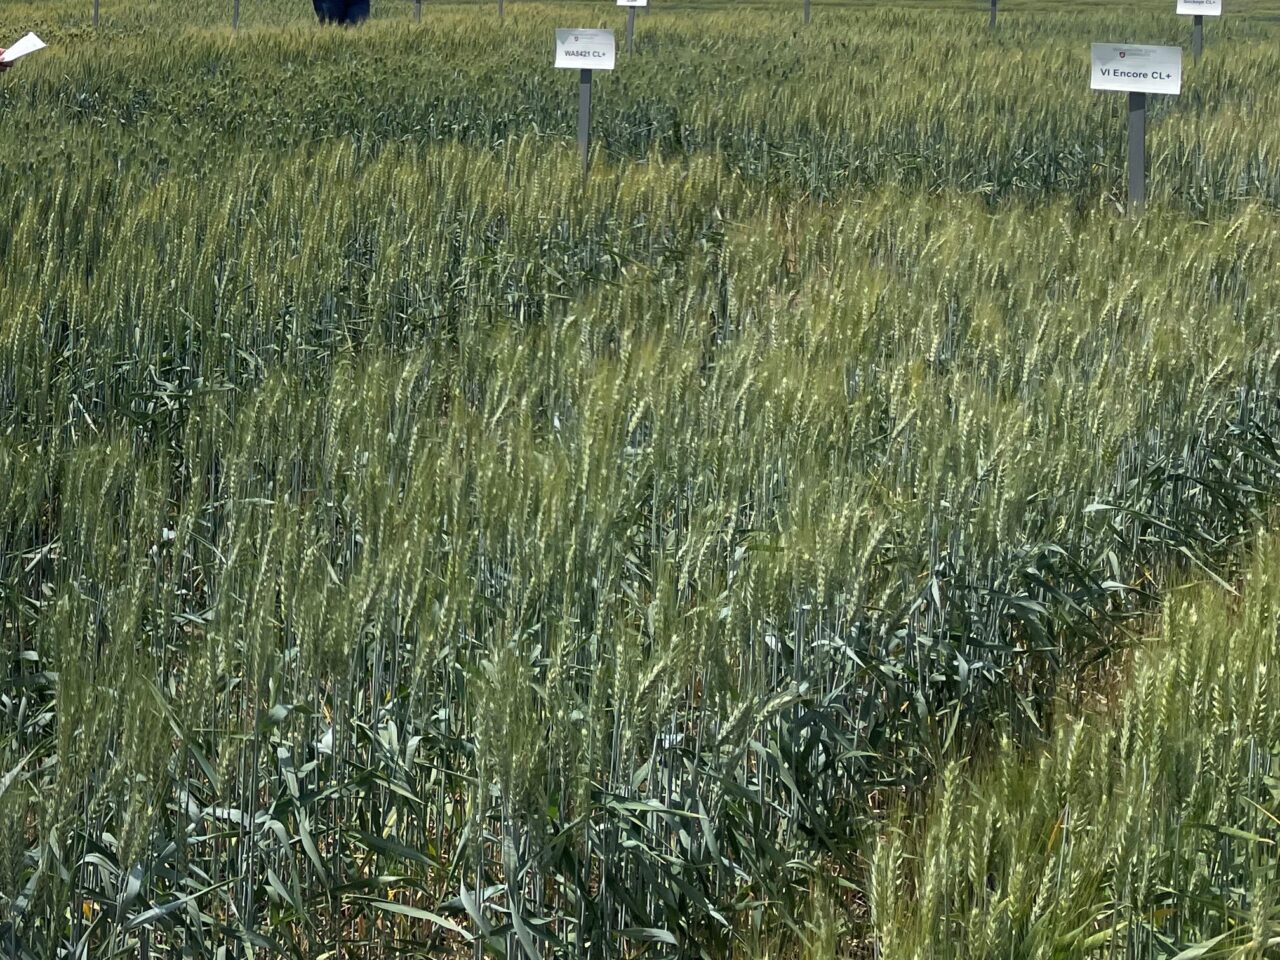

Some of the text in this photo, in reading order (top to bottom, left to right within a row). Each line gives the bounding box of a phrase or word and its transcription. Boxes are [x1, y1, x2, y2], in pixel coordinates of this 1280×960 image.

[592, 50, 606, 59] CL+
[1100, 68, 1172, 81] VI Encore CL+
